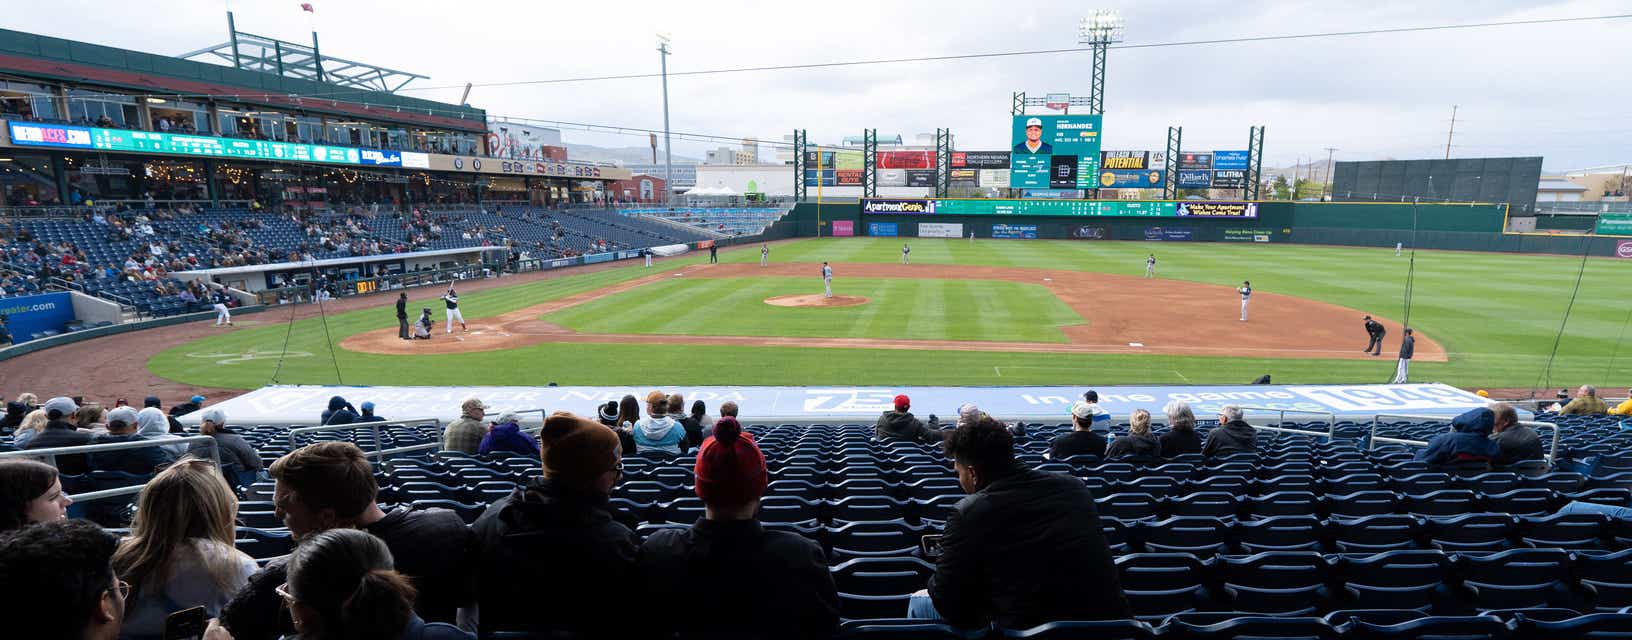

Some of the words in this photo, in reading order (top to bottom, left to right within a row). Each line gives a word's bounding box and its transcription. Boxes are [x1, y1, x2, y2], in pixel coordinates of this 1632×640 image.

[1103, 158, 1144, 169] POTENTIAL
[1217, 203, 1245, 211] Apartment
[1021, 393, 1071, 405] In
[1166, 391, 1295, 404] game
